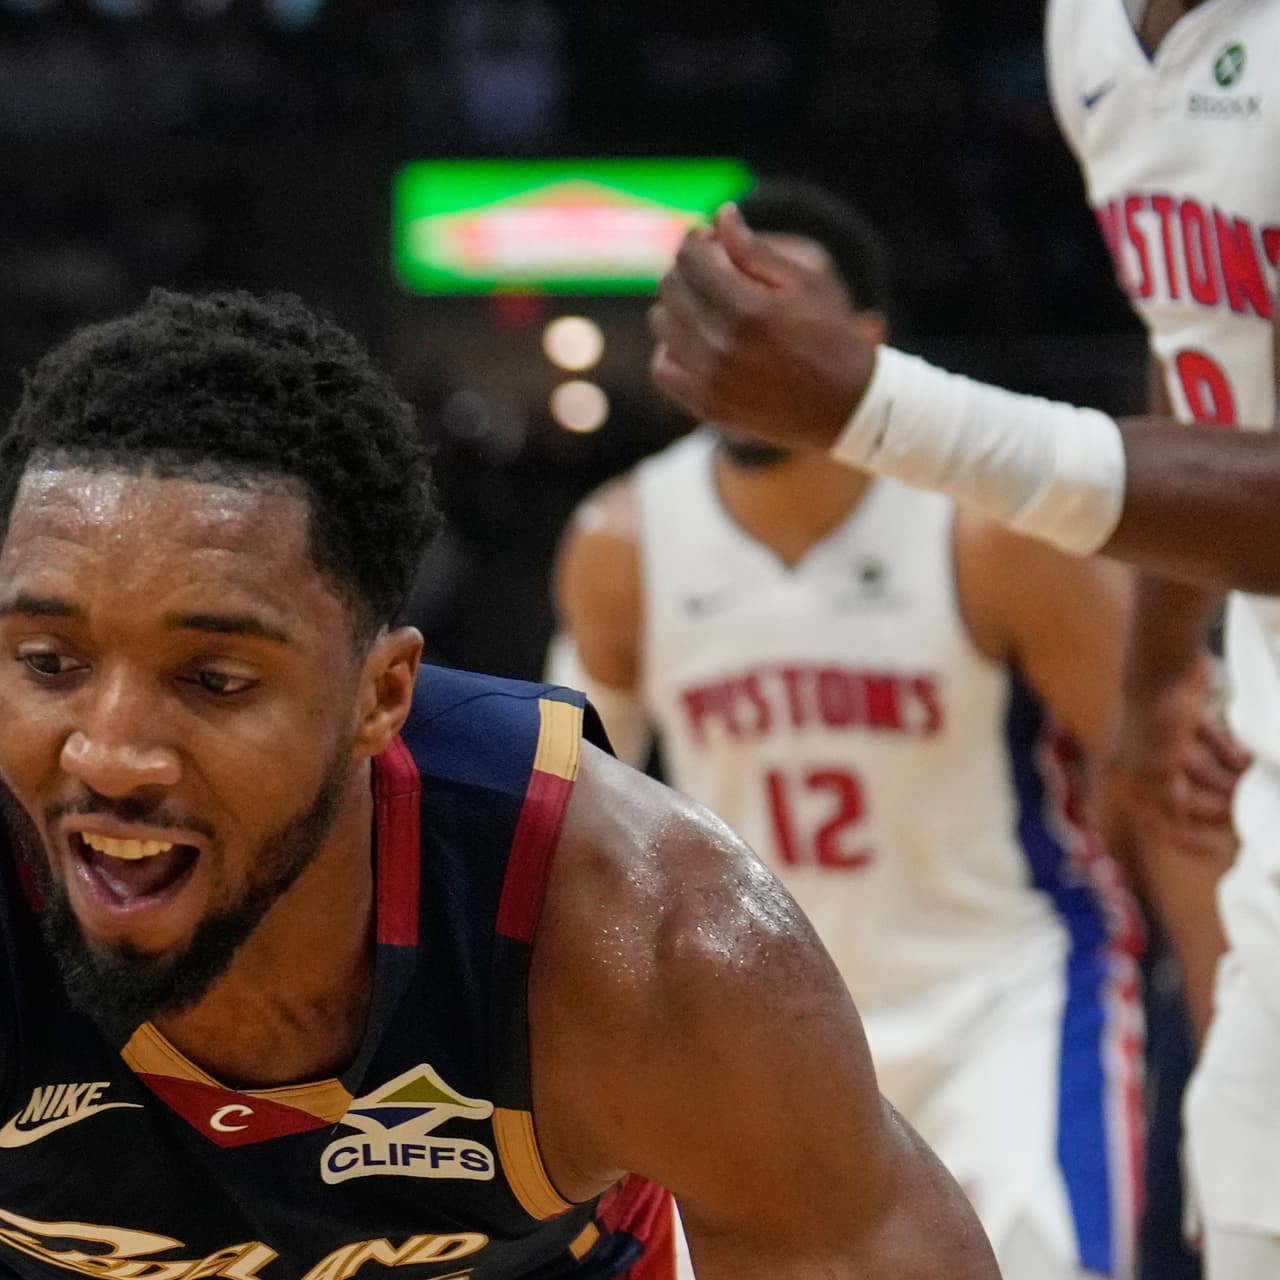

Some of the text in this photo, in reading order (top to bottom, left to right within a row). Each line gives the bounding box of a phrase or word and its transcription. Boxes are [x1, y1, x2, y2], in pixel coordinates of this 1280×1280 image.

[680, 664, 947, 746] PISTONS
[763, 764, 874, 870] 12
[18, 1081, 111, 1125] NIKE
[327, 1142, 491, 1174] CLIFFS
